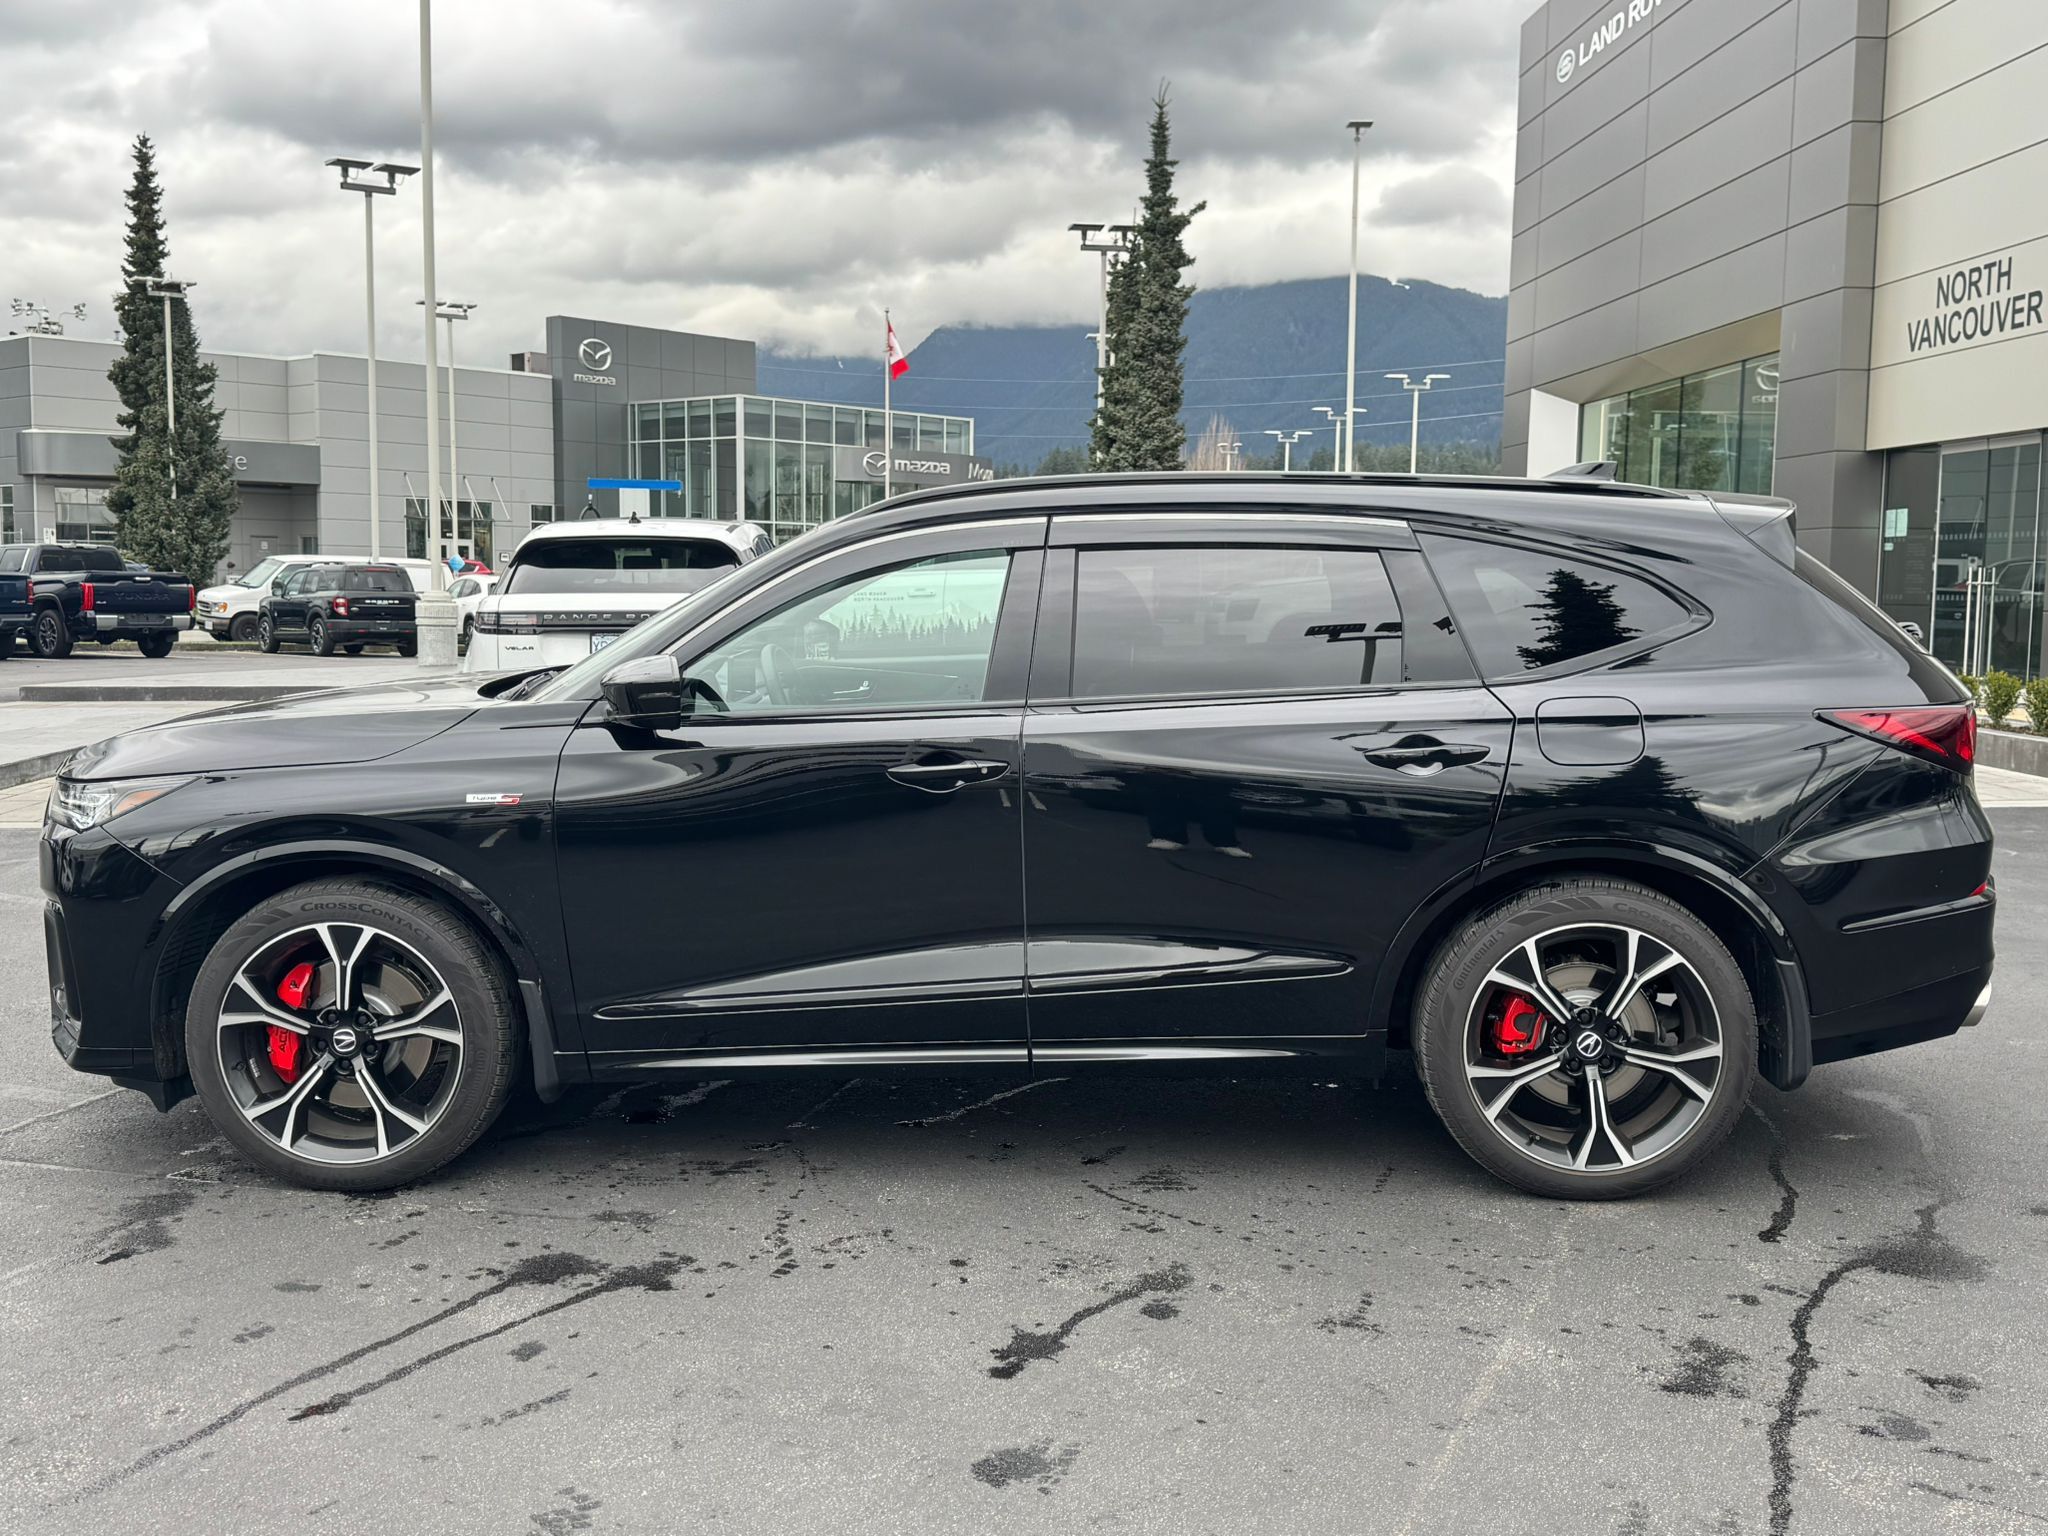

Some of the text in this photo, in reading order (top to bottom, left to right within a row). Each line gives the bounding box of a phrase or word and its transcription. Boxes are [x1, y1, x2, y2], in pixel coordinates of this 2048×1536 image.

[1579, 11, 1625, 66] LAND
[1628, 0, 1662, 28] RO
[1936, 256, 2012, 309] NORTH
[1908, 290, 2043, 352] VANCOUVER
[574, 373, 616, 386] mazda
[894, 459, 951, 474] mazda
